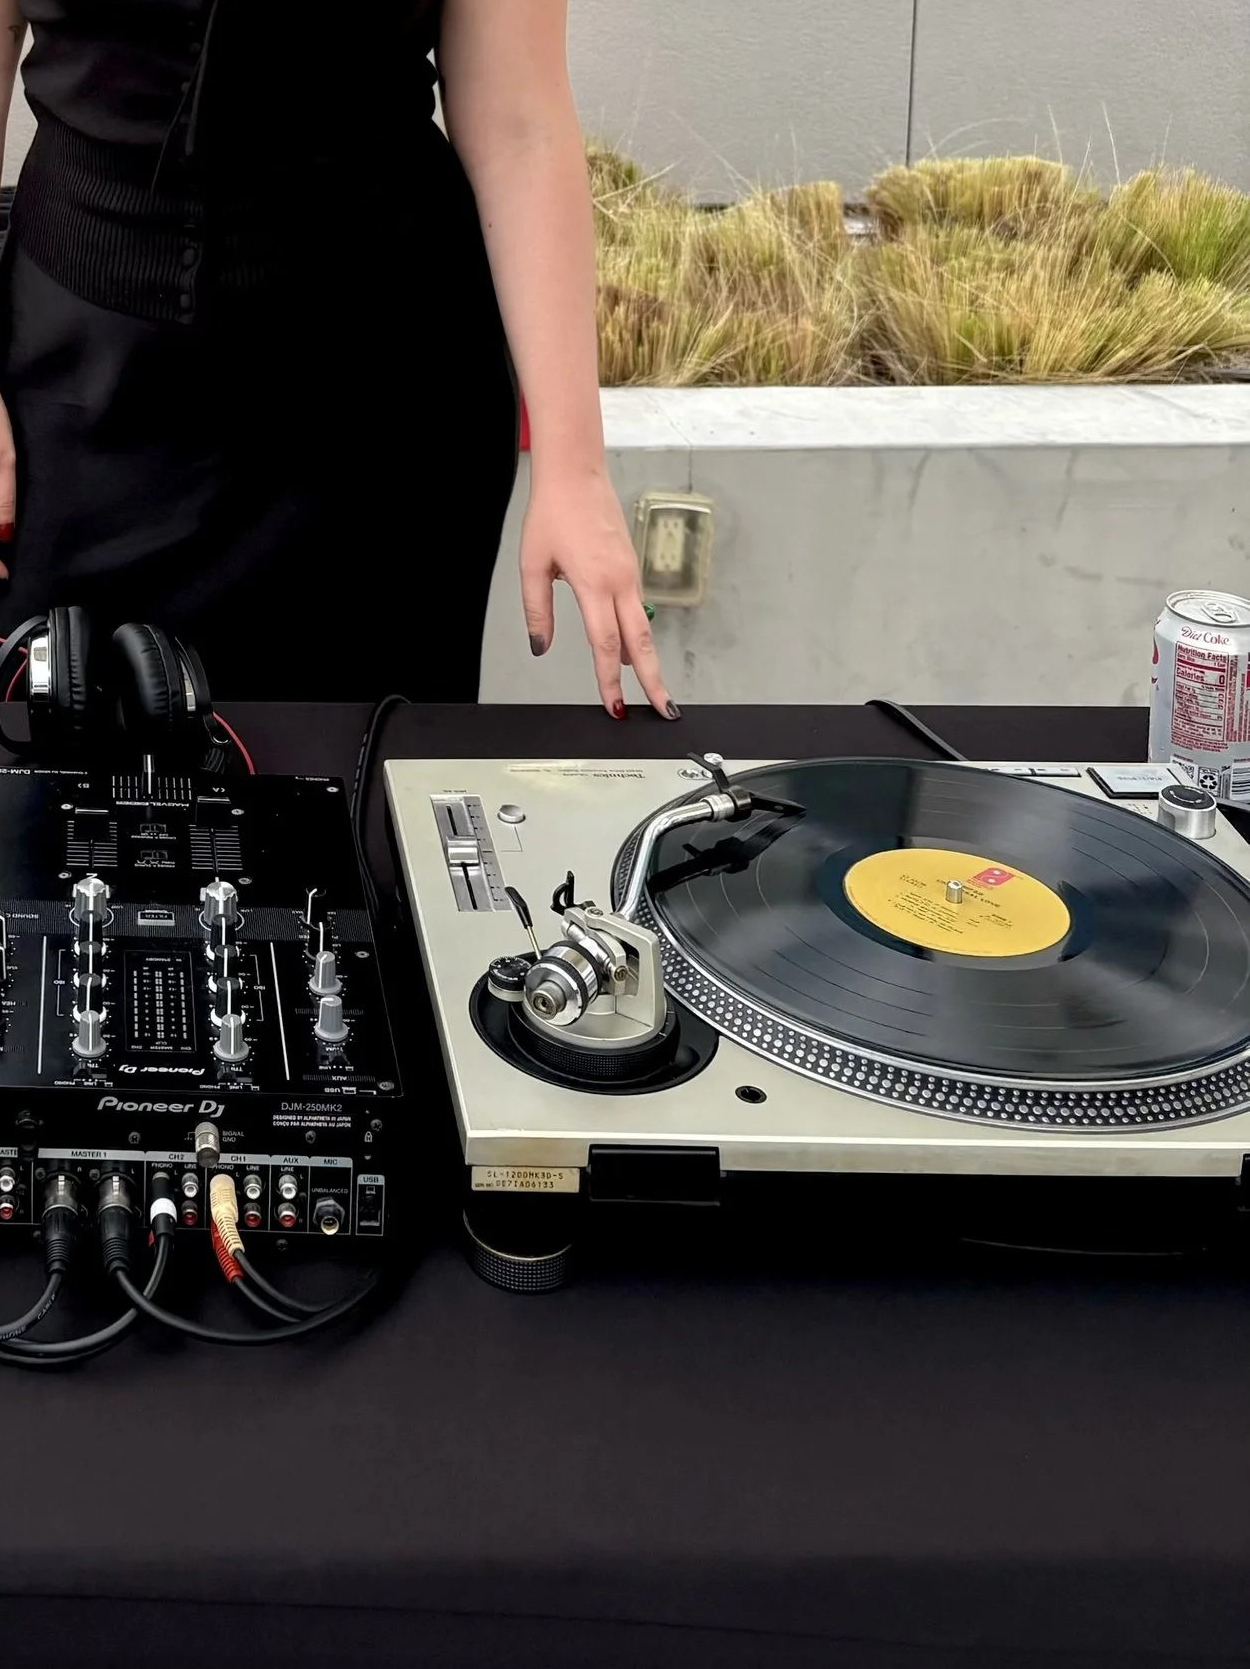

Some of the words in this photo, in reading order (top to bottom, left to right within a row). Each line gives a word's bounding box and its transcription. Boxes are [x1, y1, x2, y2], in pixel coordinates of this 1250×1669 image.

[1181, 625, 1202, 641] Diet
[1203, 631, 1230, 645] Coke
[1177, 645, 1205, 659] Nutrition
[1207, 652, 1227, 663] Facts
[1177, 667, 1205, 682] Calories
[1219, 675, 1225, 684] 0
[139, 1066, 206, 1076] Pioneer
[97, 1096, 194, 1113] Pioneer
[281, 1102, 342, 1112] DJM-250MK2
[71, 1150, 101, 1158] MASTER
[487, 1171, 563, 1180] SL-1200MK3D-S
